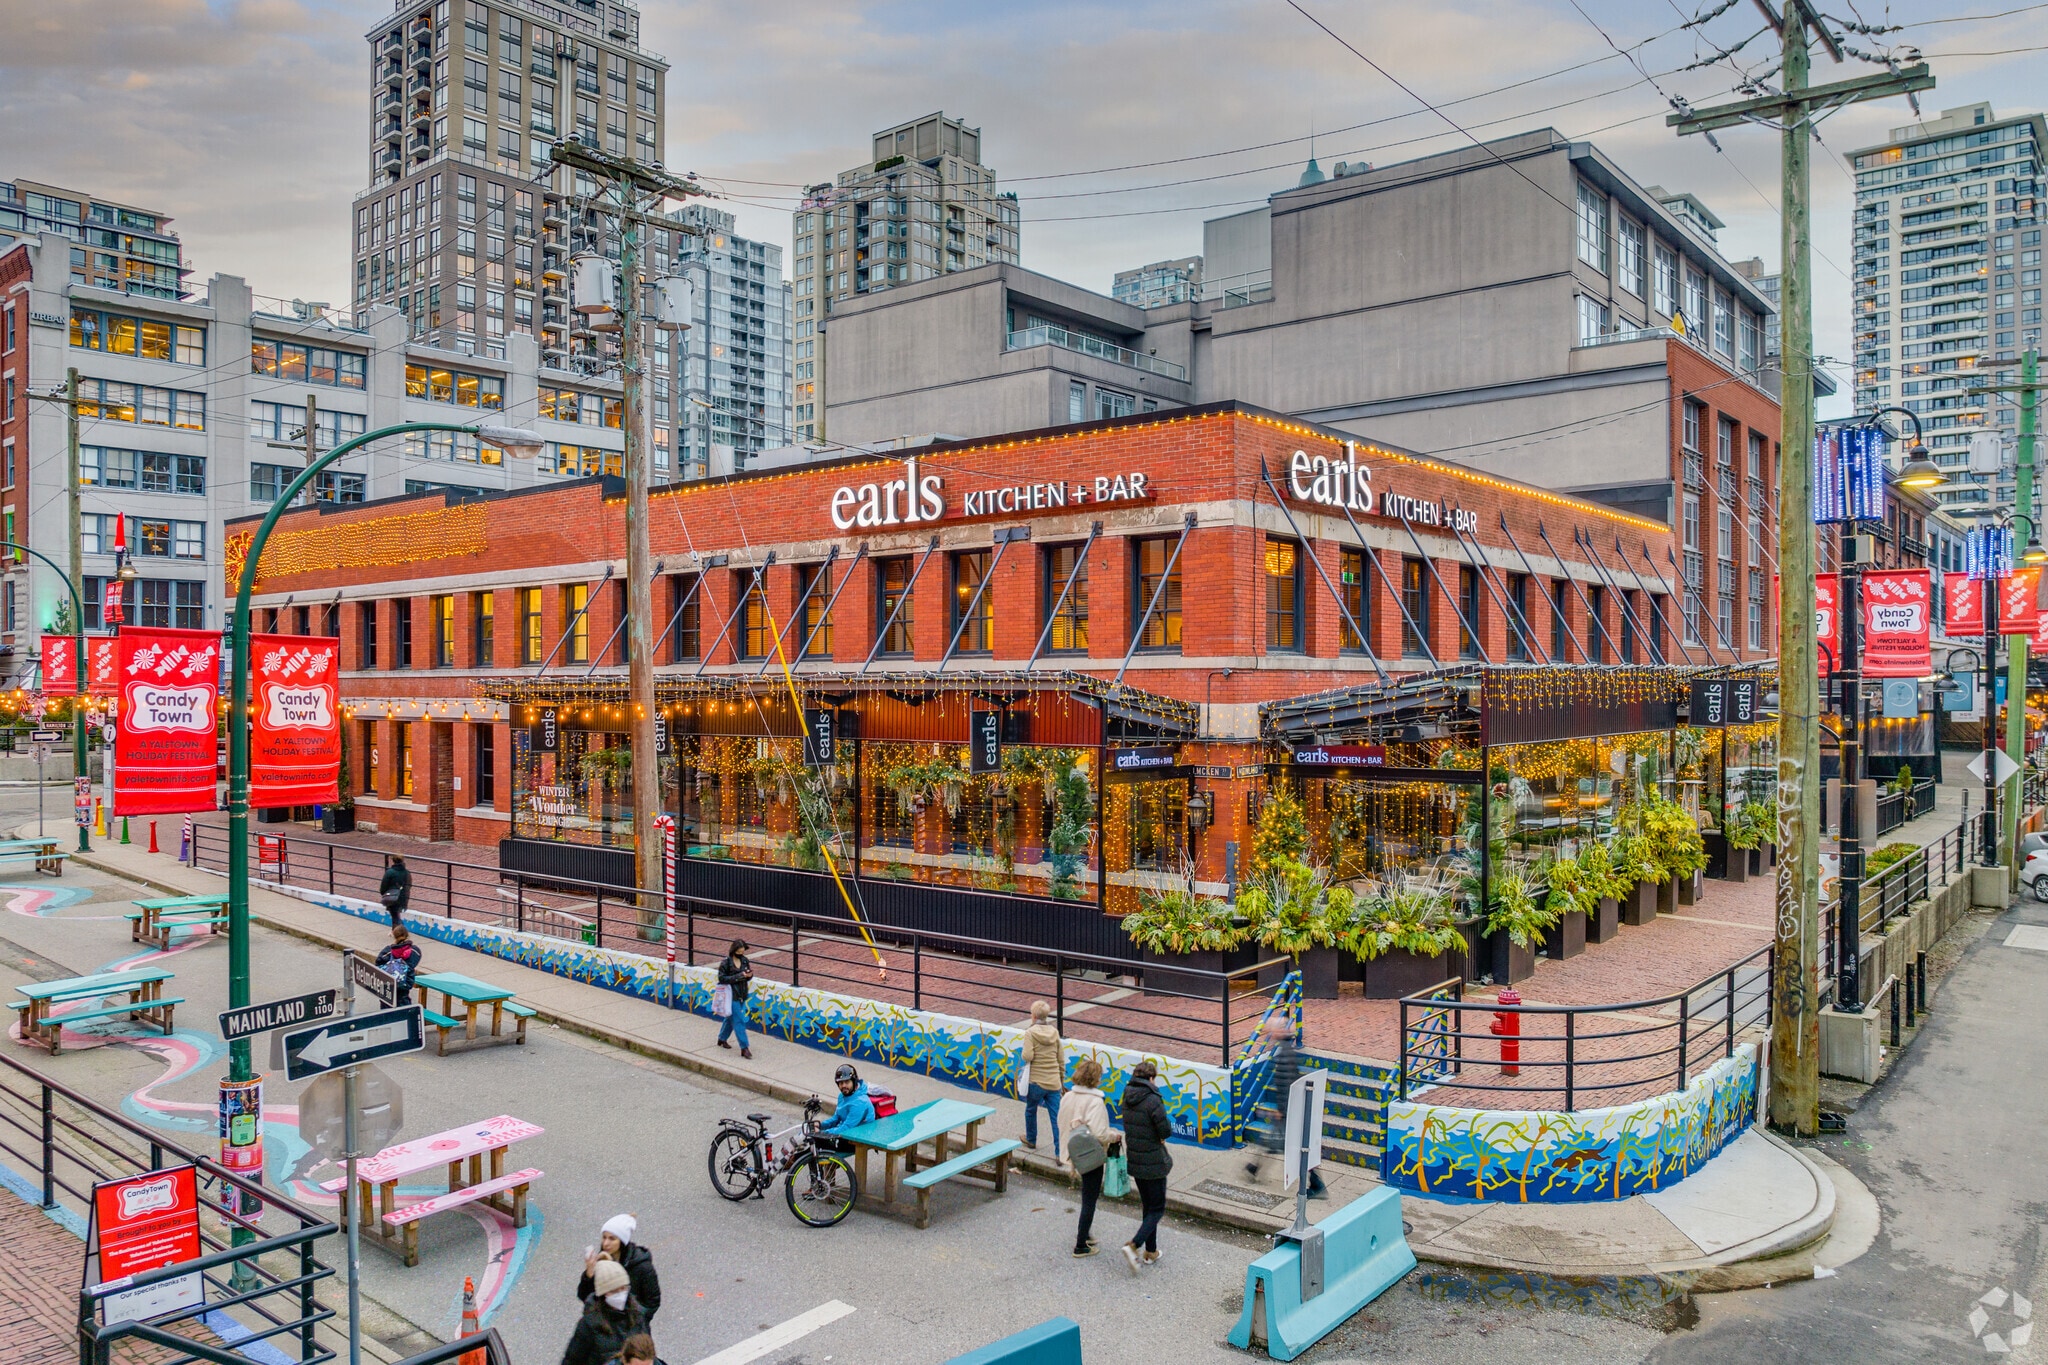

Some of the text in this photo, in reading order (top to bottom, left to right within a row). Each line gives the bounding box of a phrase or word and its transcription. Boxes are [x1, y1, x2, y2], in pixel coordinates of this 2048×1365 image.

[831, 456, 1147, 530] earls KITCHEN + BAR
[1291, 440, 1478, 533] earls KITCHEN + BAR
[145, 691, 199, 711] Candy
[278, 691, 321, 708] Candy
[1704, 684, 1722, 723] earls
[1734, 683, 1751, 720] earls
[149, 709, 193, 723] Town
[282, 707, 317, 721] Town
[541, 710, 556, 748] earls
[655, 711, 666, 752] earls
[815, 712, 830, 759] earls
[140, 741, 199, 749] A YALETOWN
[274, 737, 326, 745] A YALETOWN
[982, 715, 997, 766] earls
[126, 751, 210, 760] HOLIDAY FESTIVAL
[262, 746, 333, 756] HOLIDAY FESTIVAL
[1117, 750, 1140, 767] earls
[1140, 757, 1160, 767] KITCHEN
[1164, 756, 1173, 765] BAR
[1297, 748, 1328, 763] earls
[1330, 755, 1361, 764] KITCHEN
[1367, 756, 1382, 764] BAR
[124, 774, 210, 785] yaletowninfo.com
[261, 771, 333, 781] yaletowninfo.com
[539, 785, 570, 798] WINTER
[529, 796, 577, 815] Wonder
[355, 963, 385, 993] Helmcken
[317, 995, 327, 1005] ST
[314, 1003, 333, 1015] 1100
[229, 1001, 305, 1035] MAINLAND
[126, 1184, 169, 1198] CandyTown
[117, 1218, 182, 1239] Brought to you by
[120, 1290, 133, 1300] Our
[133, 1285, 157, 1297] special
[158, 1279, 180, 1290] thanks
